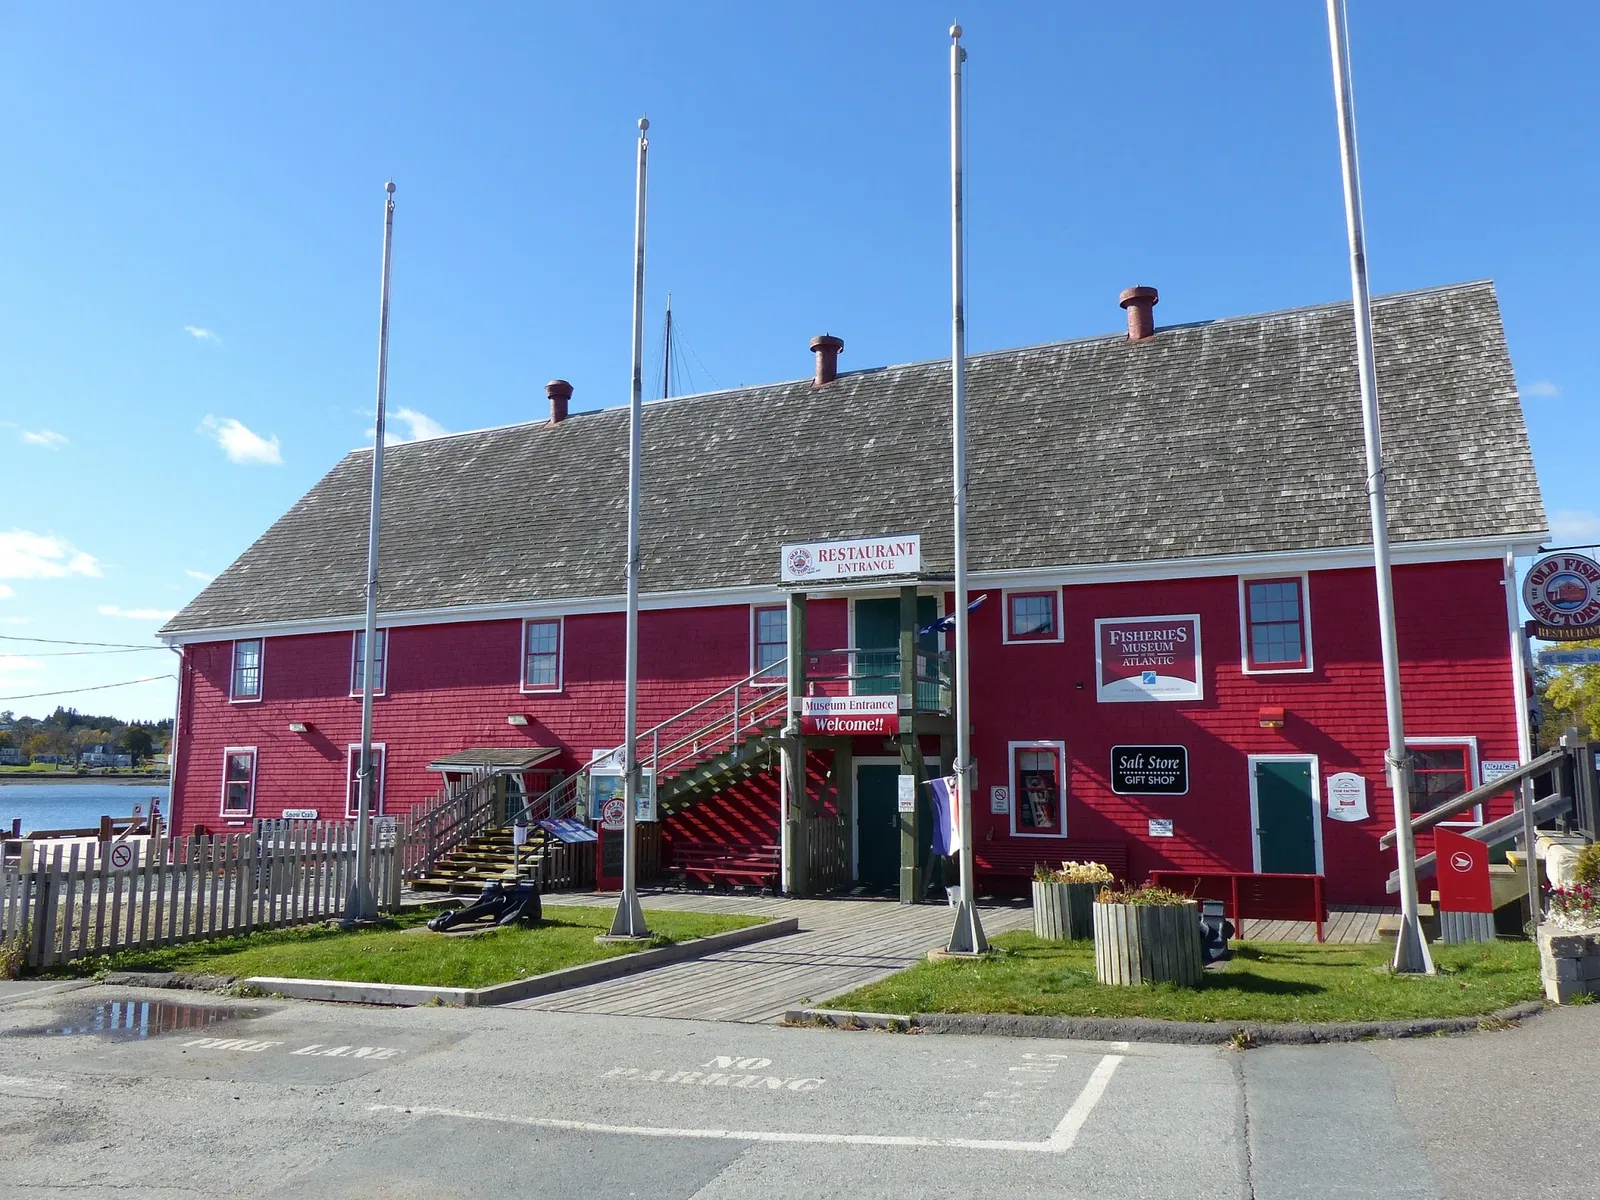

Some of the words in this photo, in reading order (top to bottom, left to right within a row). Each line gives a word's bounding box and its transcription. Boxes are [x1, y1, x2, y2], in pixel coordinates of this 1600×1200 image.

[818, 542, 916, 562] RESTAURANT
[837, 559, 895, 573] ENTRANCE
[1531, 561, 1559, 586] OLD
[1564, 559, 1600, 584] FISH
[1532, 599, 1600, 627] FACTORY
[1109, 627, 1187, 646] FISHERIES
[1122, 642, 1174, 653] MUSEUM
[1122, 656, 1175, 666] ATLANTIC
[805, 701, 846, 711] Museum
[849, 700, 894, 710] Entrance
[815, 717, 884, 731] Welcome!!
[1119, 753, 1145, 769] Salt
[1147, 755, 1179, 769] Store
[1124, 776, 1146, 785] GIFT
[1148, 776, 1175, 785] SHOP
[301, 810, 314, 818] Crab
[289, 1044, 407, 1060] LANE
[700, 1055, 773, 1070] NO
[600, 1066, 827, 1091] PARKING
